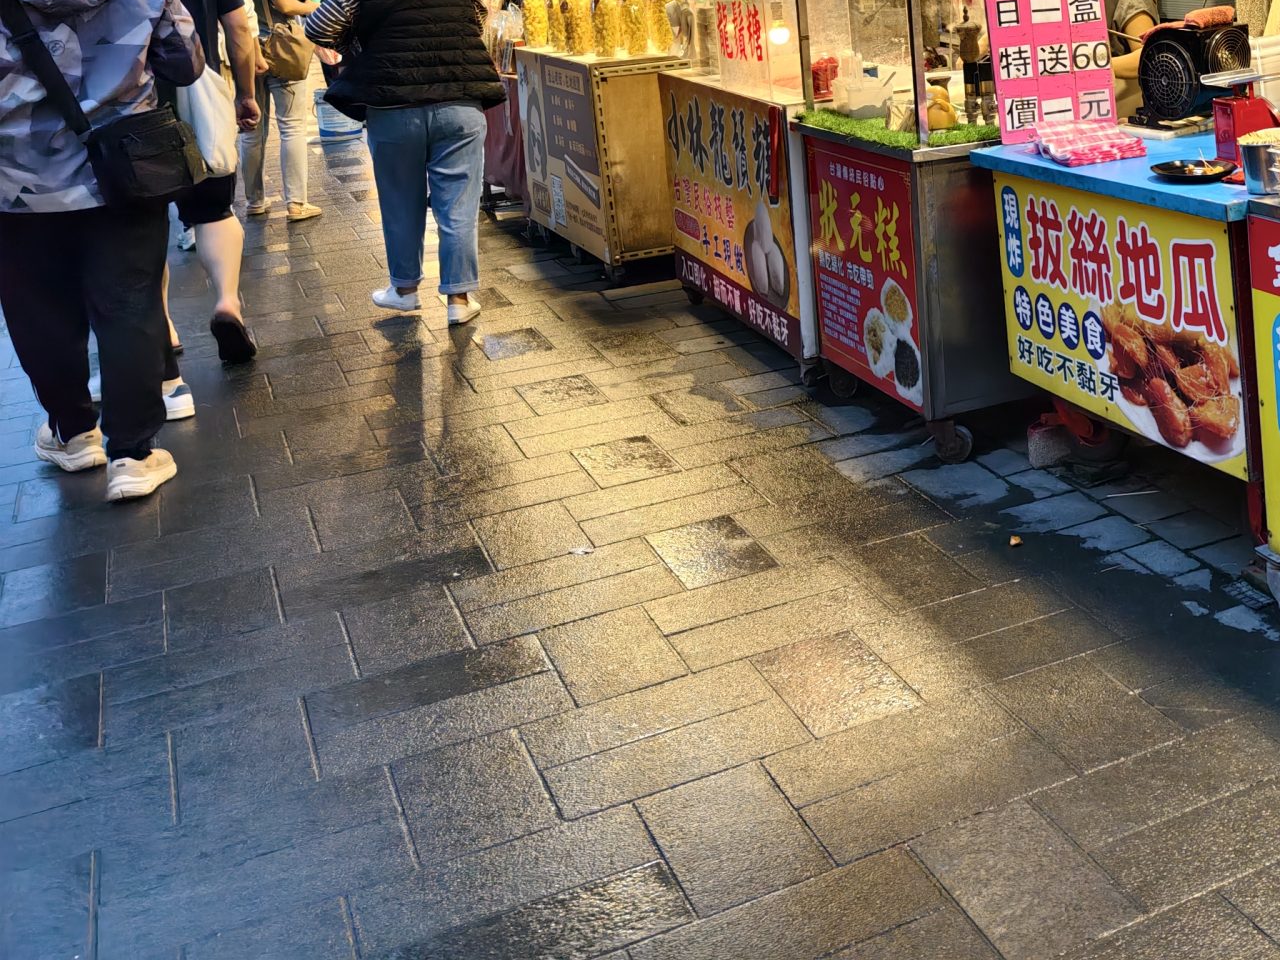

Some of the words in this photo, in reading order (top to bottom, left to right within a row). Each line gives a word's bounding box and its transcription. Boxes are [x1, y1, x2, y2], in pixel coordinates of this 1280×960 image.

[819, 178, 908, 280] 狀元糕
[1001, 191, 1023, 268] 現炸
[1025, 196, 1227, 344] 拔絲地瓜
[1014, 289, 1105, 357] 特色美食
[1017, 335, 1119, 404] 好吃不黏牙
